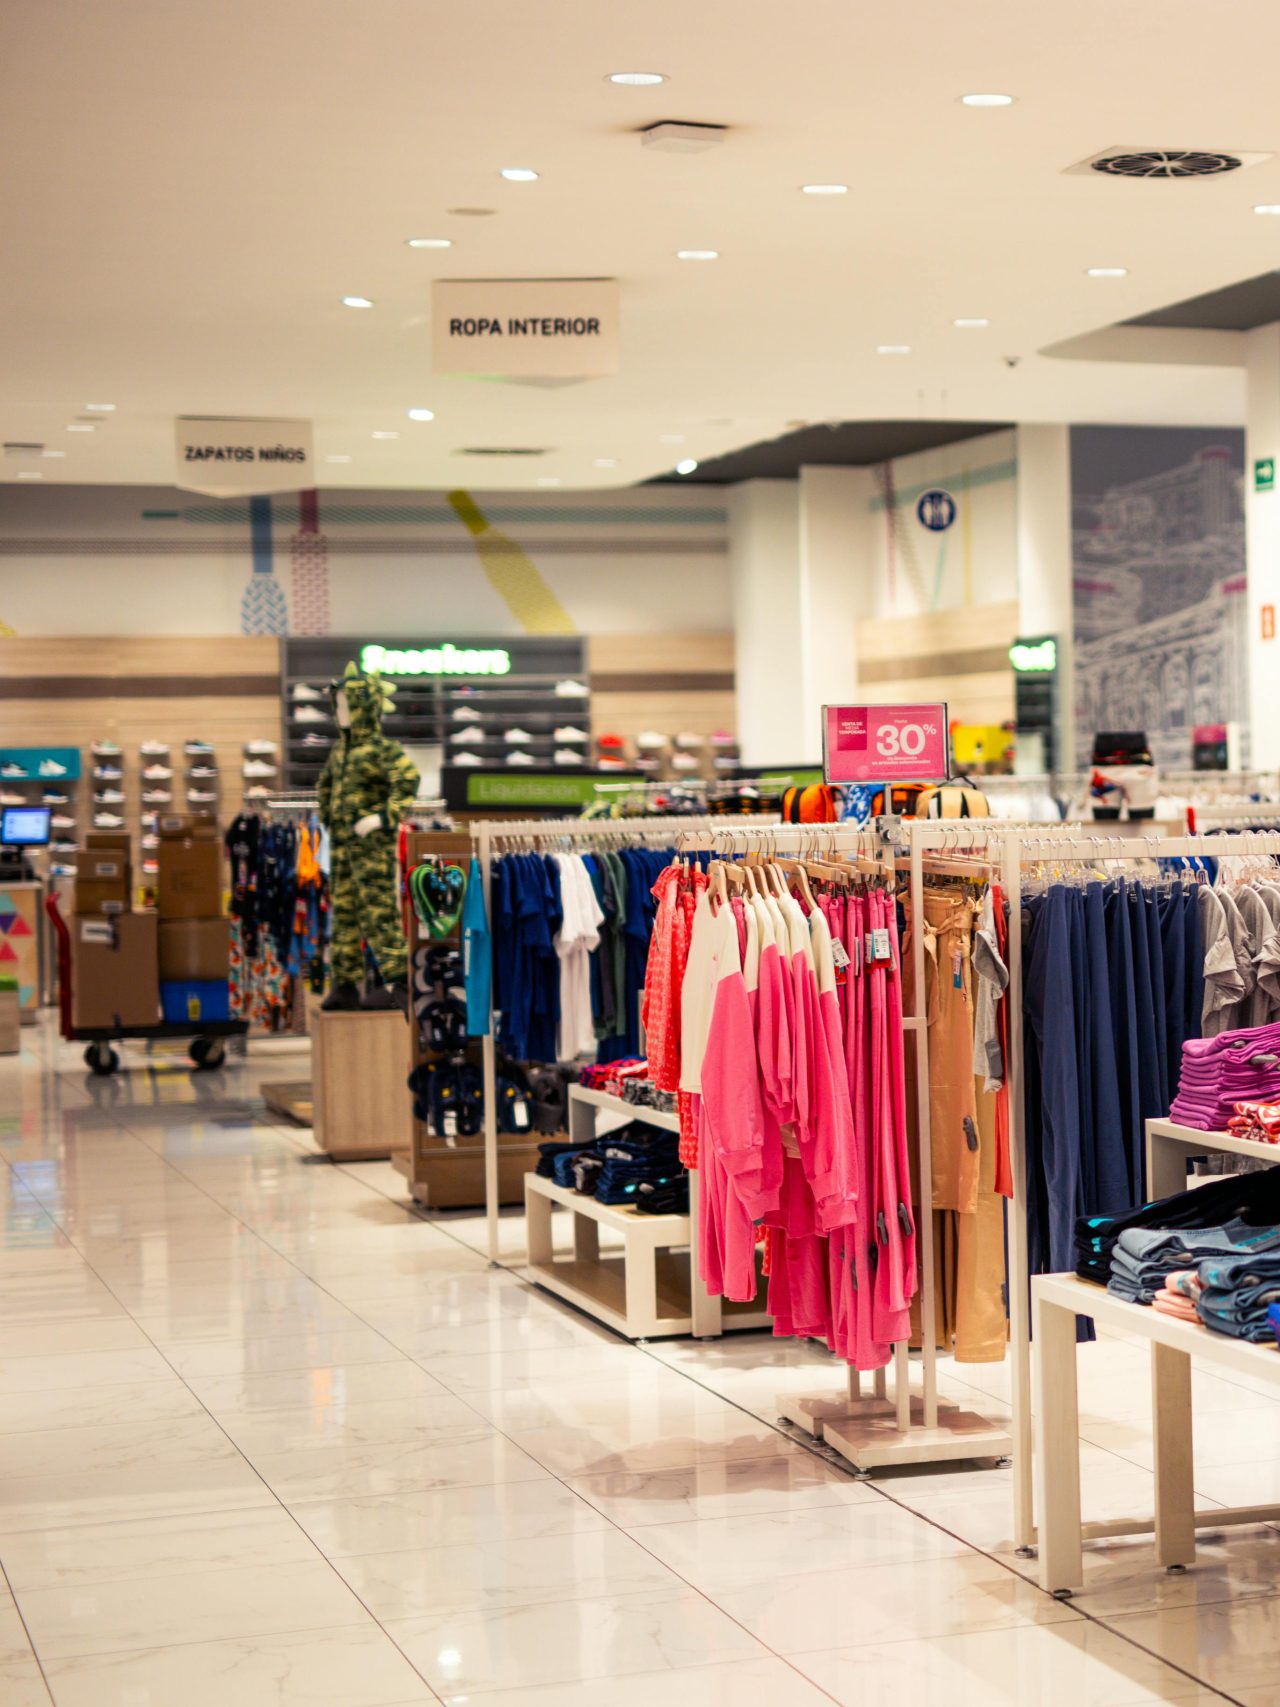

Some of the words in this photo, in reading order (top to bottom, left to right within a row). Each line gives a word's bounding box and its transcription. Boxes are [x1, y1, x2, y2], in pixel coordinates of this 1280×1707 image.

[449, 318, 502, 336] ROPA
[508, 317, 601, 336] INTERIOR
[185, 445, 254, 462] ZAPATOS
[259, 443, 306, 463] NIÑOS
[876, 723, 937, 756] 30%
